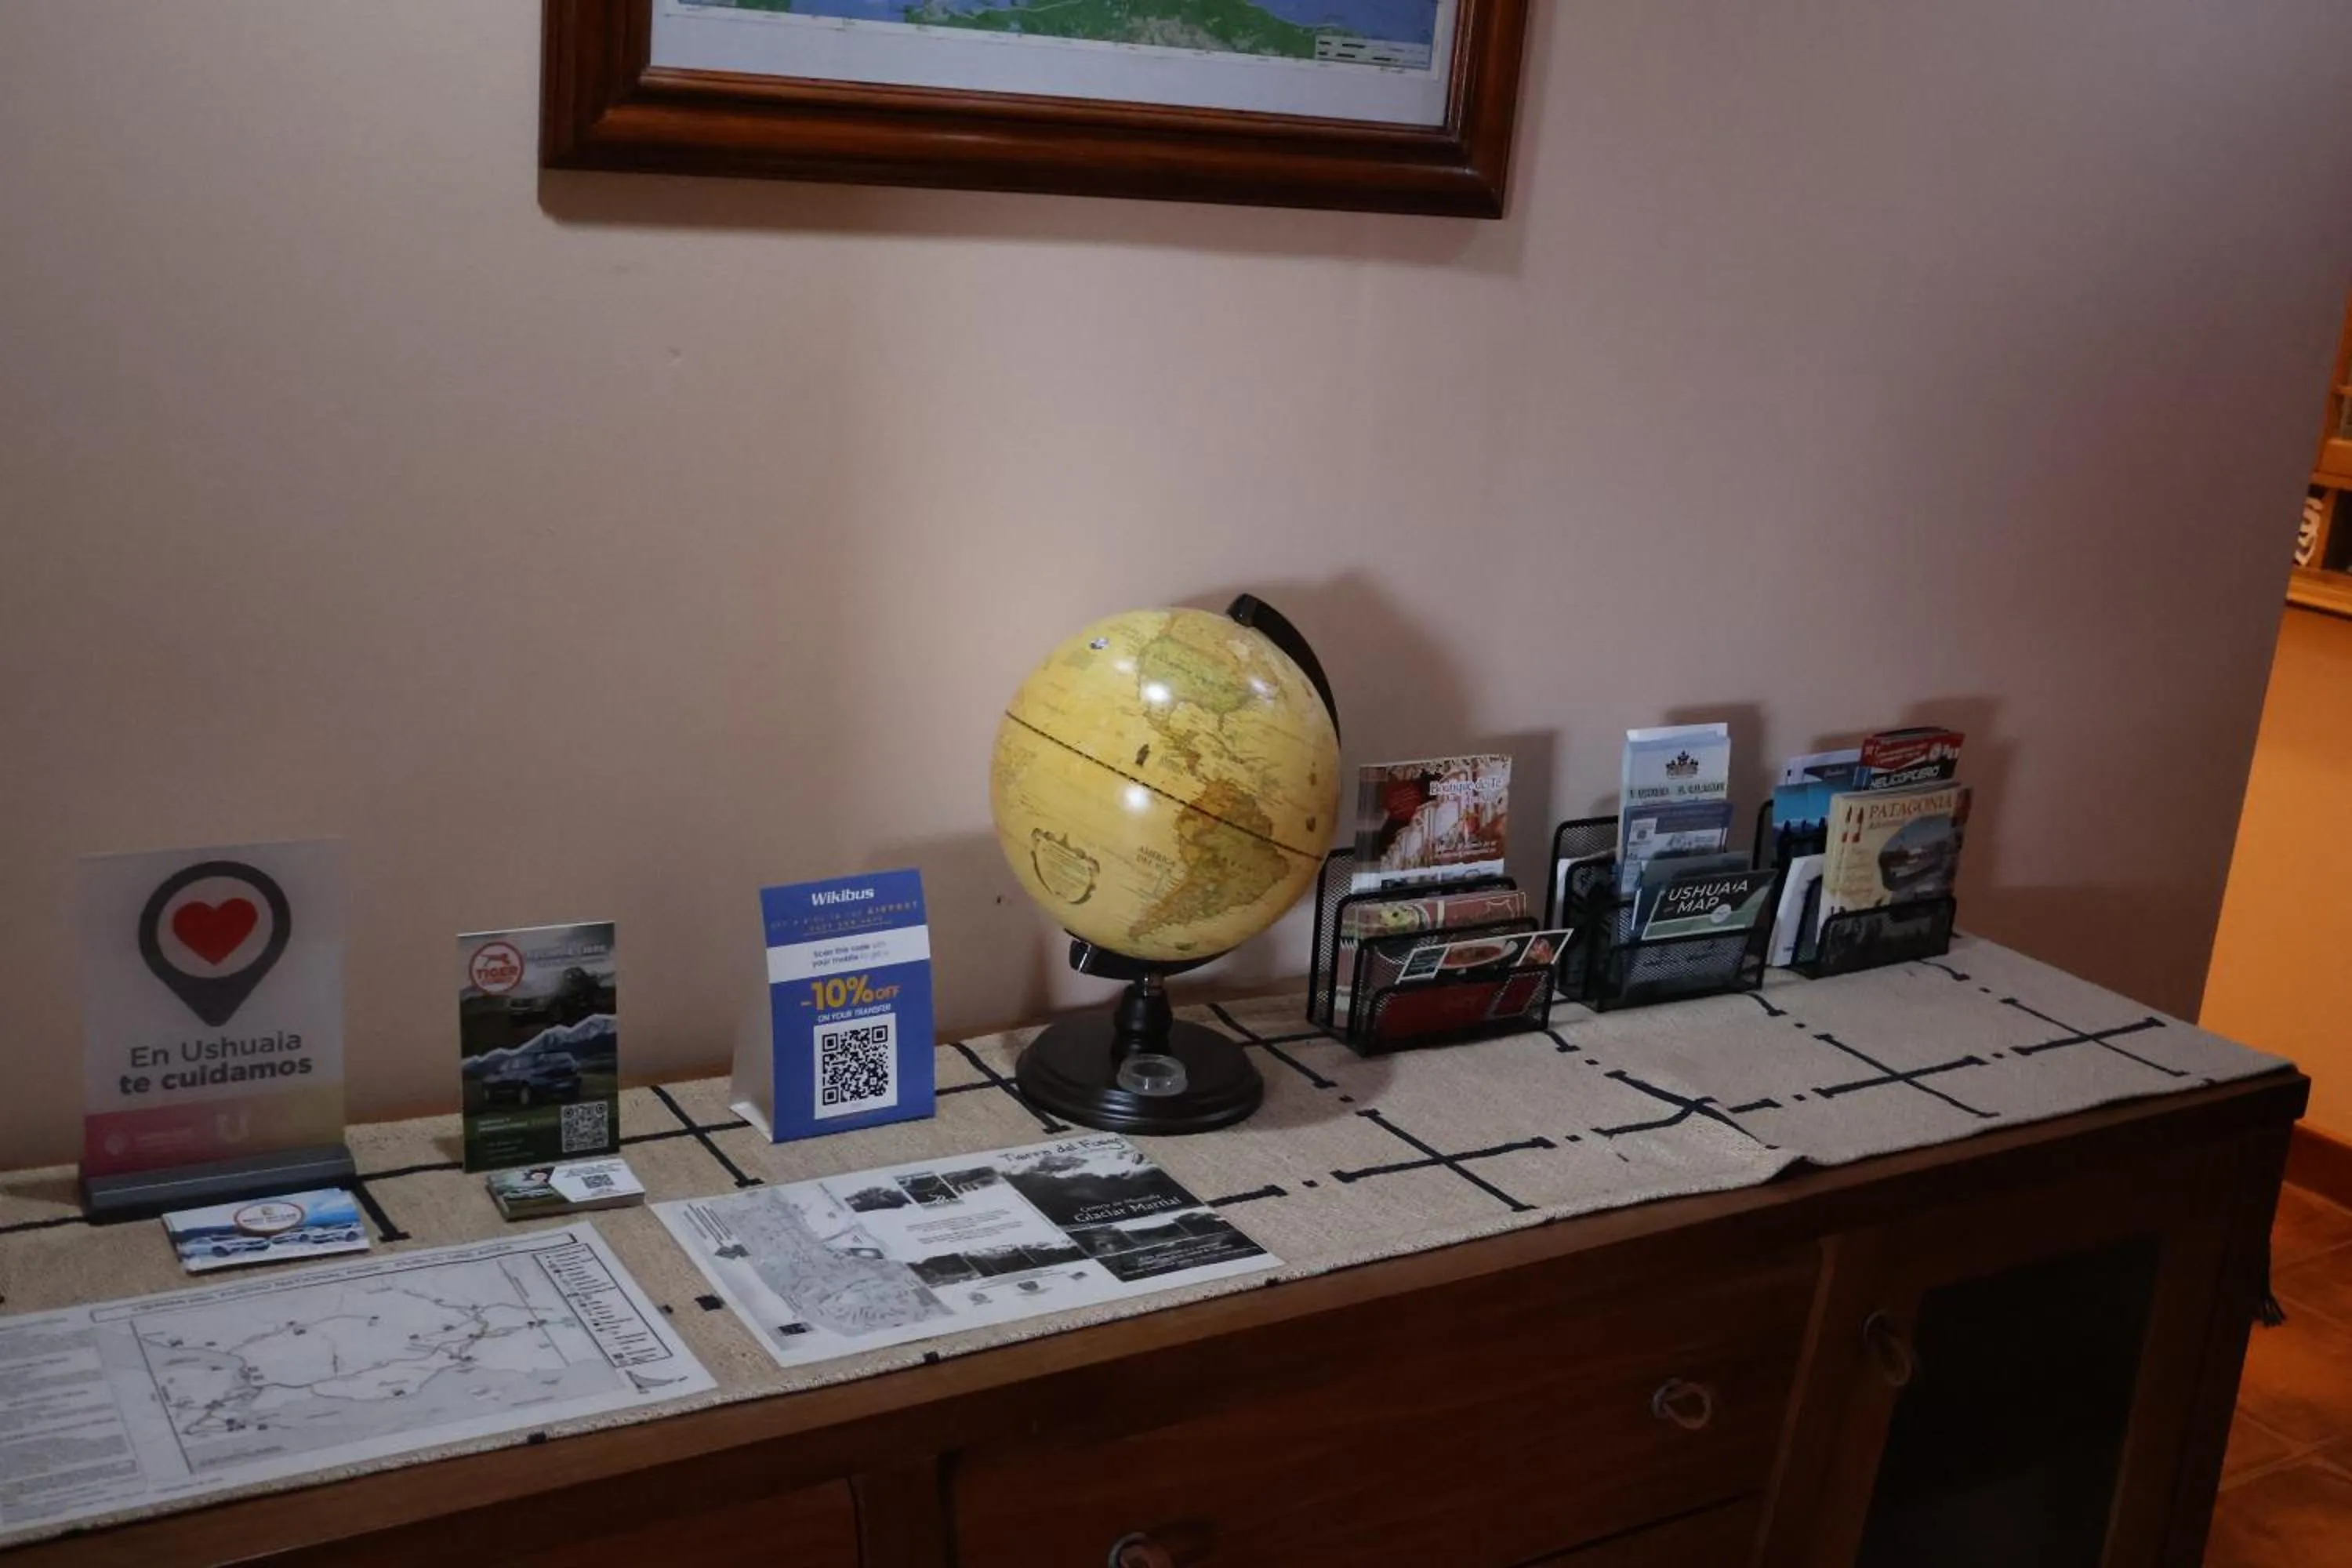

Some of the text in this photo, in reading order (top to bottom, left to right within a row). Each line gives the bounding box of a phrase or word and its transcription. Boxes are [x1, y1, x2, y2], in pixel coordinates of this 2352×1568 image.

[1870, 794, 1953, 819] PATAGONIA
[811, 887, 875, 907] Wikibus
[1668, 879, 1748, 902] USHUAIA
[1677, 896, 1720, 914] MAP
[476, 965, 518, 980] TIGER
[801, 975, 901, 1011] -10% OFF
[817, 1013, 830, 1023] ON
[832, 1009, 853, 1021] YOUR
[130, 1030, 303, 1069] En Ushuaia
[119, 1056, 314, 1095] te cuidamos
[1073, 1206, 1127, 1223] Glaciar
[1128, 1195, 1183, 1214] Martial
